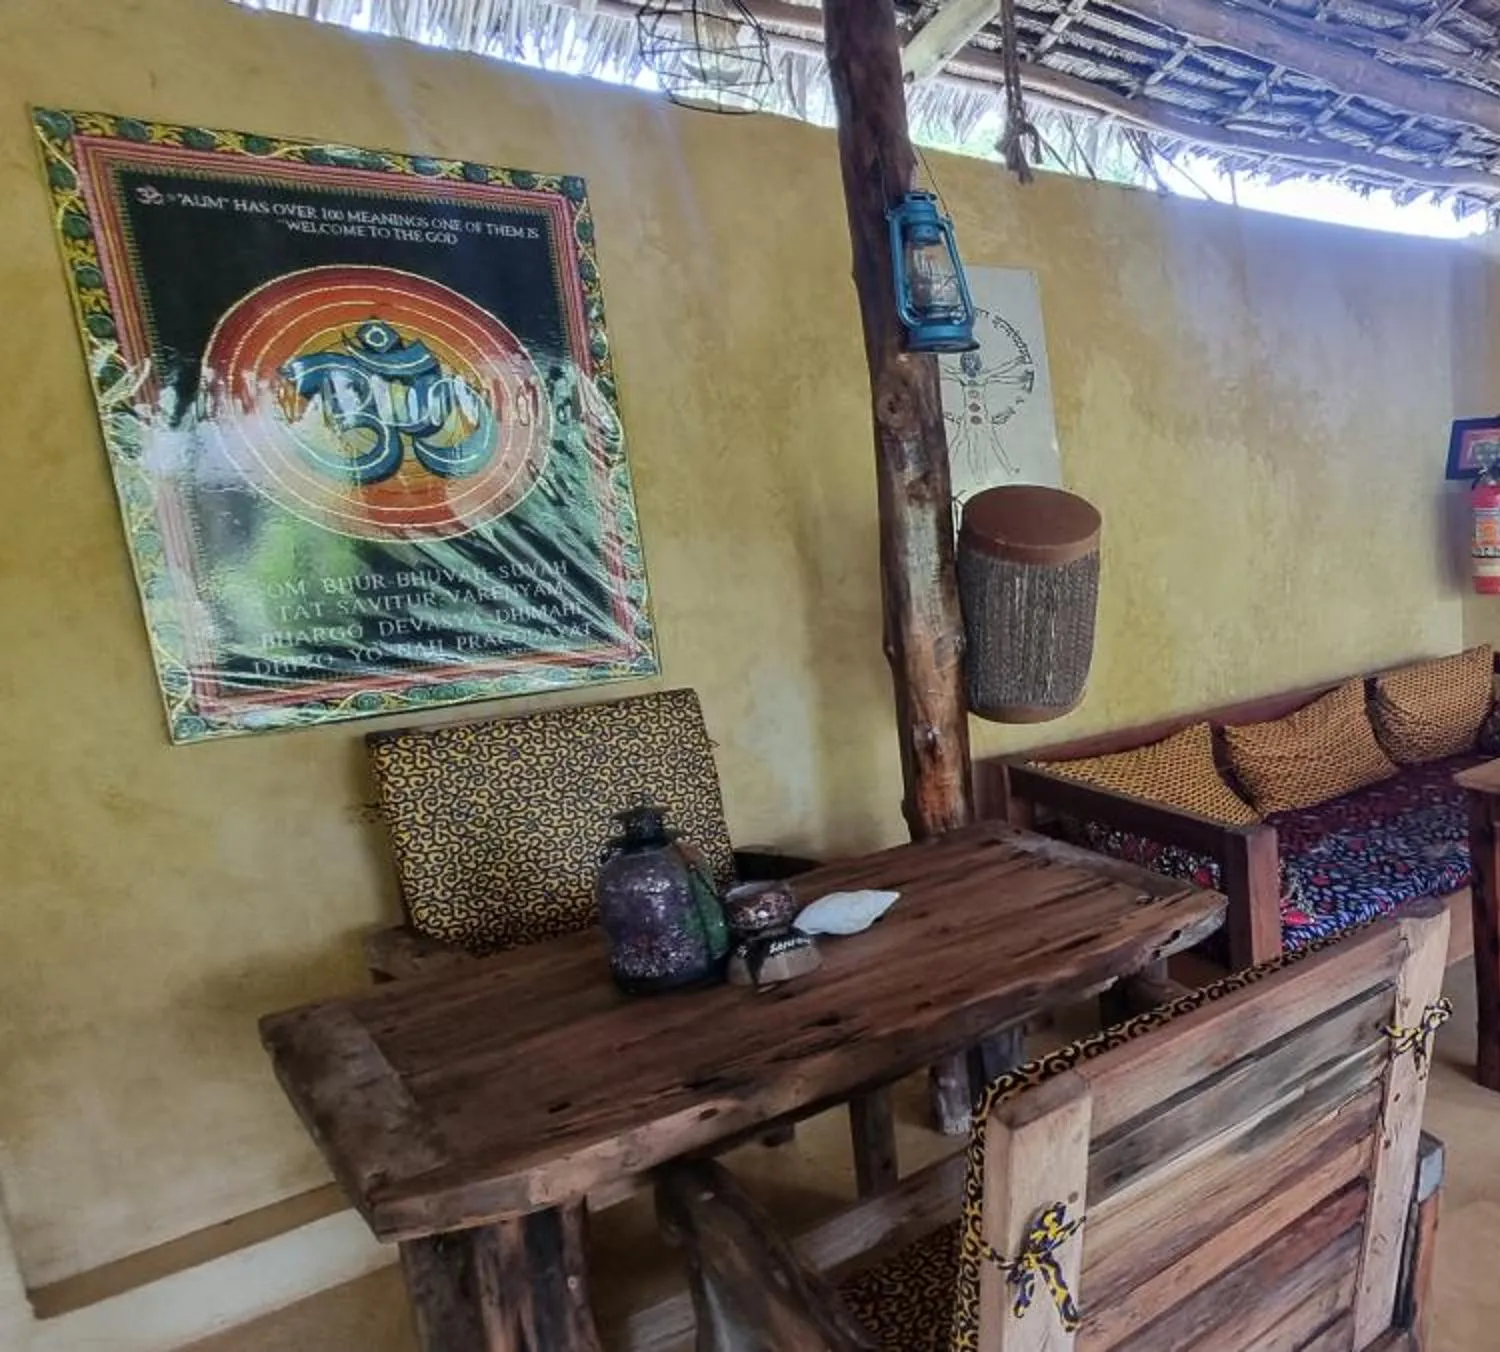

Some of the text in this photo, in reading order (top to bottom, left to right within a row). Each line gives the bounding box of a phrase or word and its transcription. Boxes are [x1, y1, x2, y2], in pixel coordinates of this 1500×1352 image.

[233, 199, 270, 214] HAS
[272, 203, 317, 219] OVER
[347, 210, 429, 229] MEANINGS
[431, 217, 462, 232] ONE
[465, 220, 481, 234] OF
[486, 223, 525, 238] THEM
[526, 227, 541, 239] IS
[367, 225, 391, 238] TO
[394, 227, 425, 242] THE
[425, 231, 459, 245] GOD
[266, 577, 308, 599] OM
[279, 602, 324, 622] TAT
[337, 591, 437, 615] SAVITUR
[350, 646, 384, 664] YO
